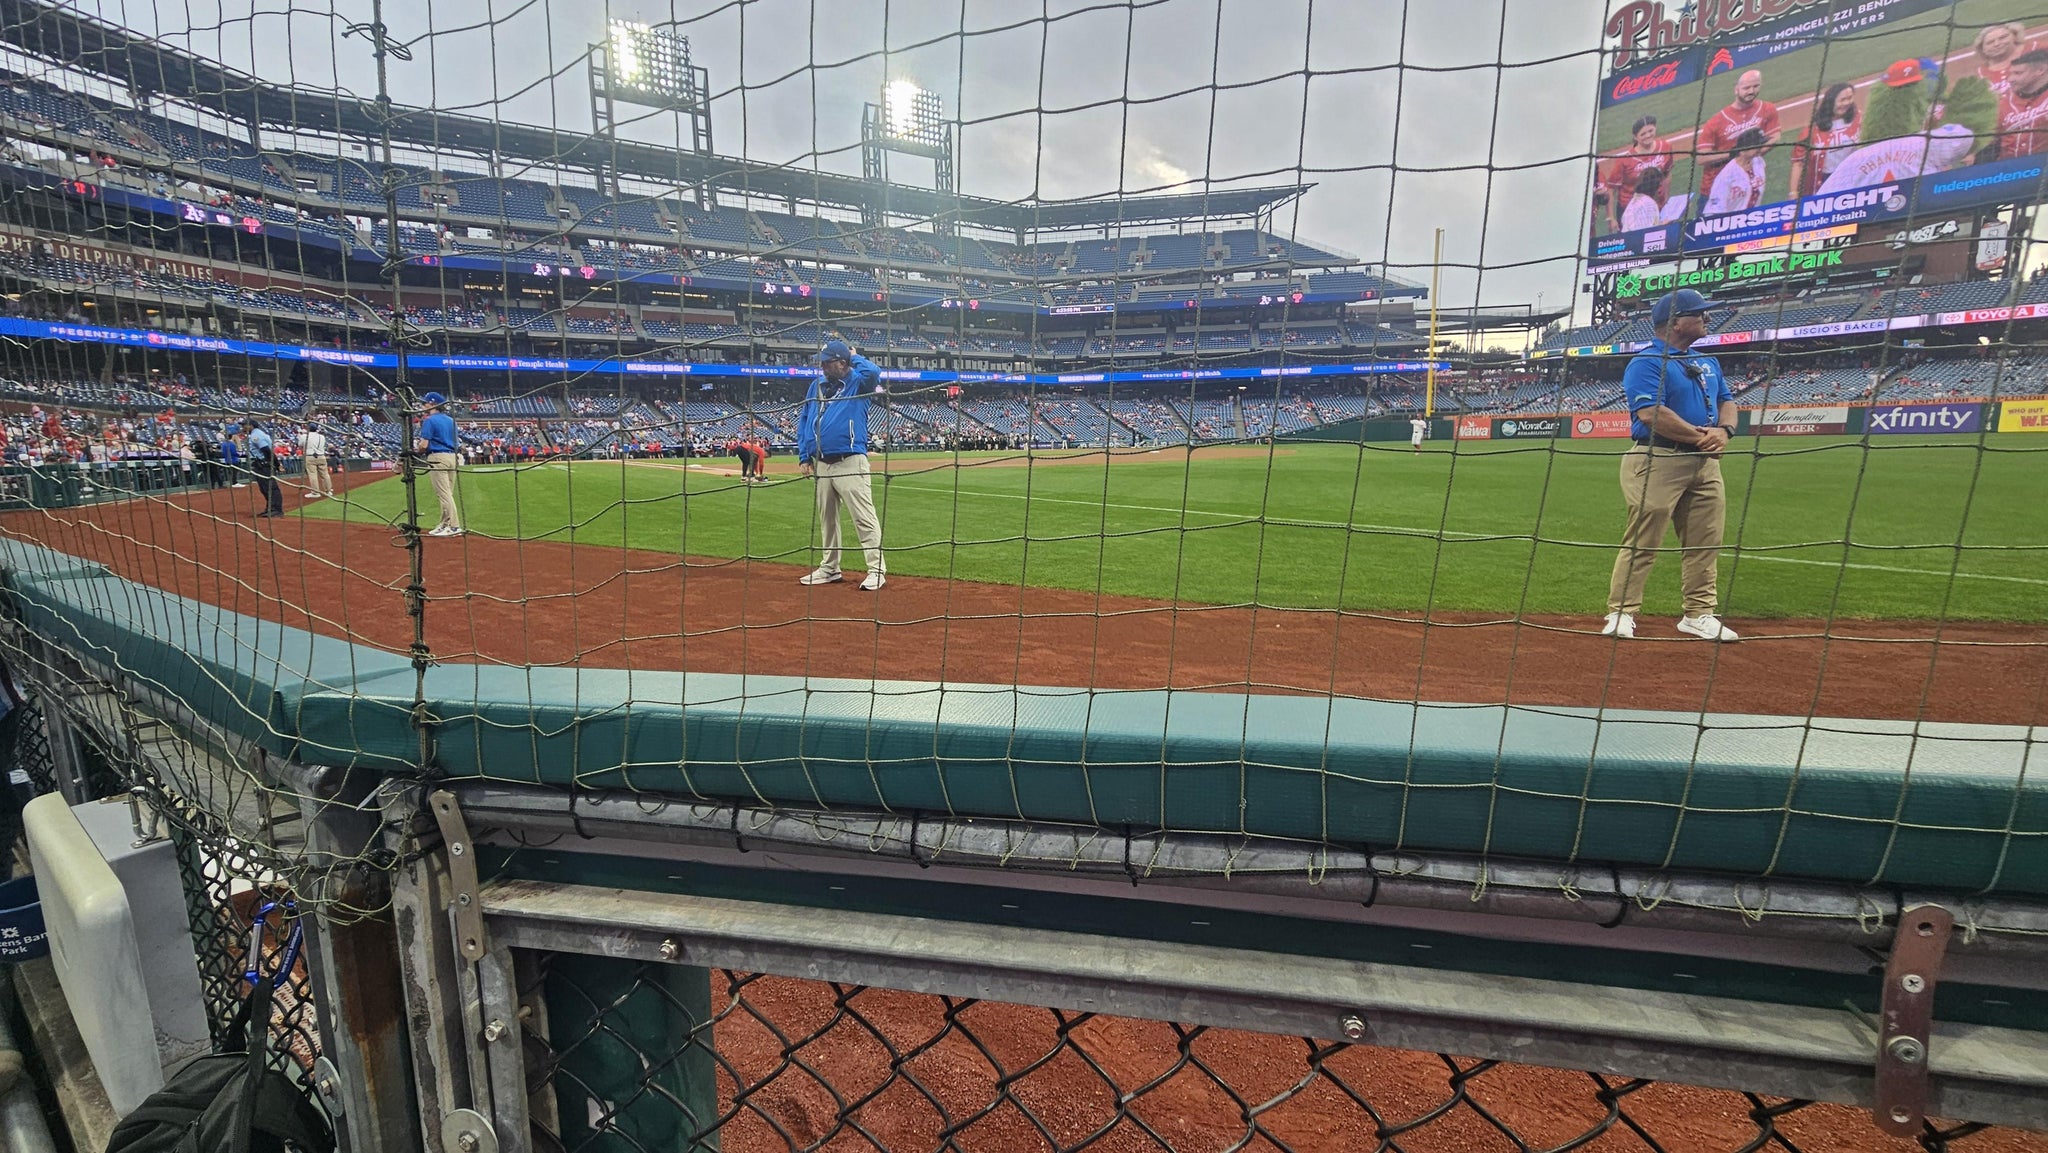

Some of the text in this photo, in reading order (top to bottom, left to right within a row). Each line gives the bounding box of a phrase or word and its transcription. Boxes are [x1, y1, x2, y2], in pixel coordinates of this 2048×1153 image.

[1933, 167, 2041, 194] Independence
[1694, 185, 1899, 236] NURSES NIGHT
[1715, 229, 1764, 242] PRESENTED
[1767, 227, 1779, 235] BY
[1831, 209, 1867, 223] Health
[1598, 238, 1625, 248] Driving
[1645, 267, 1725, 291] Citzens
[1729, 255, 1785, 280] Bank
[1788, 249, 1843, 271] Park
[1969, 307, 2030, 321] TOYOTA
[1722, 332, 1750, 344] NECA
[1593, 344, 1613, 354] UKG
[1767, 410, 1827, 423] Yuengling
[1869, 406, 1973, 430] xfinity
[1776, 424, 1816, 433] LAGER
[2, 946, 28, 955] Park
